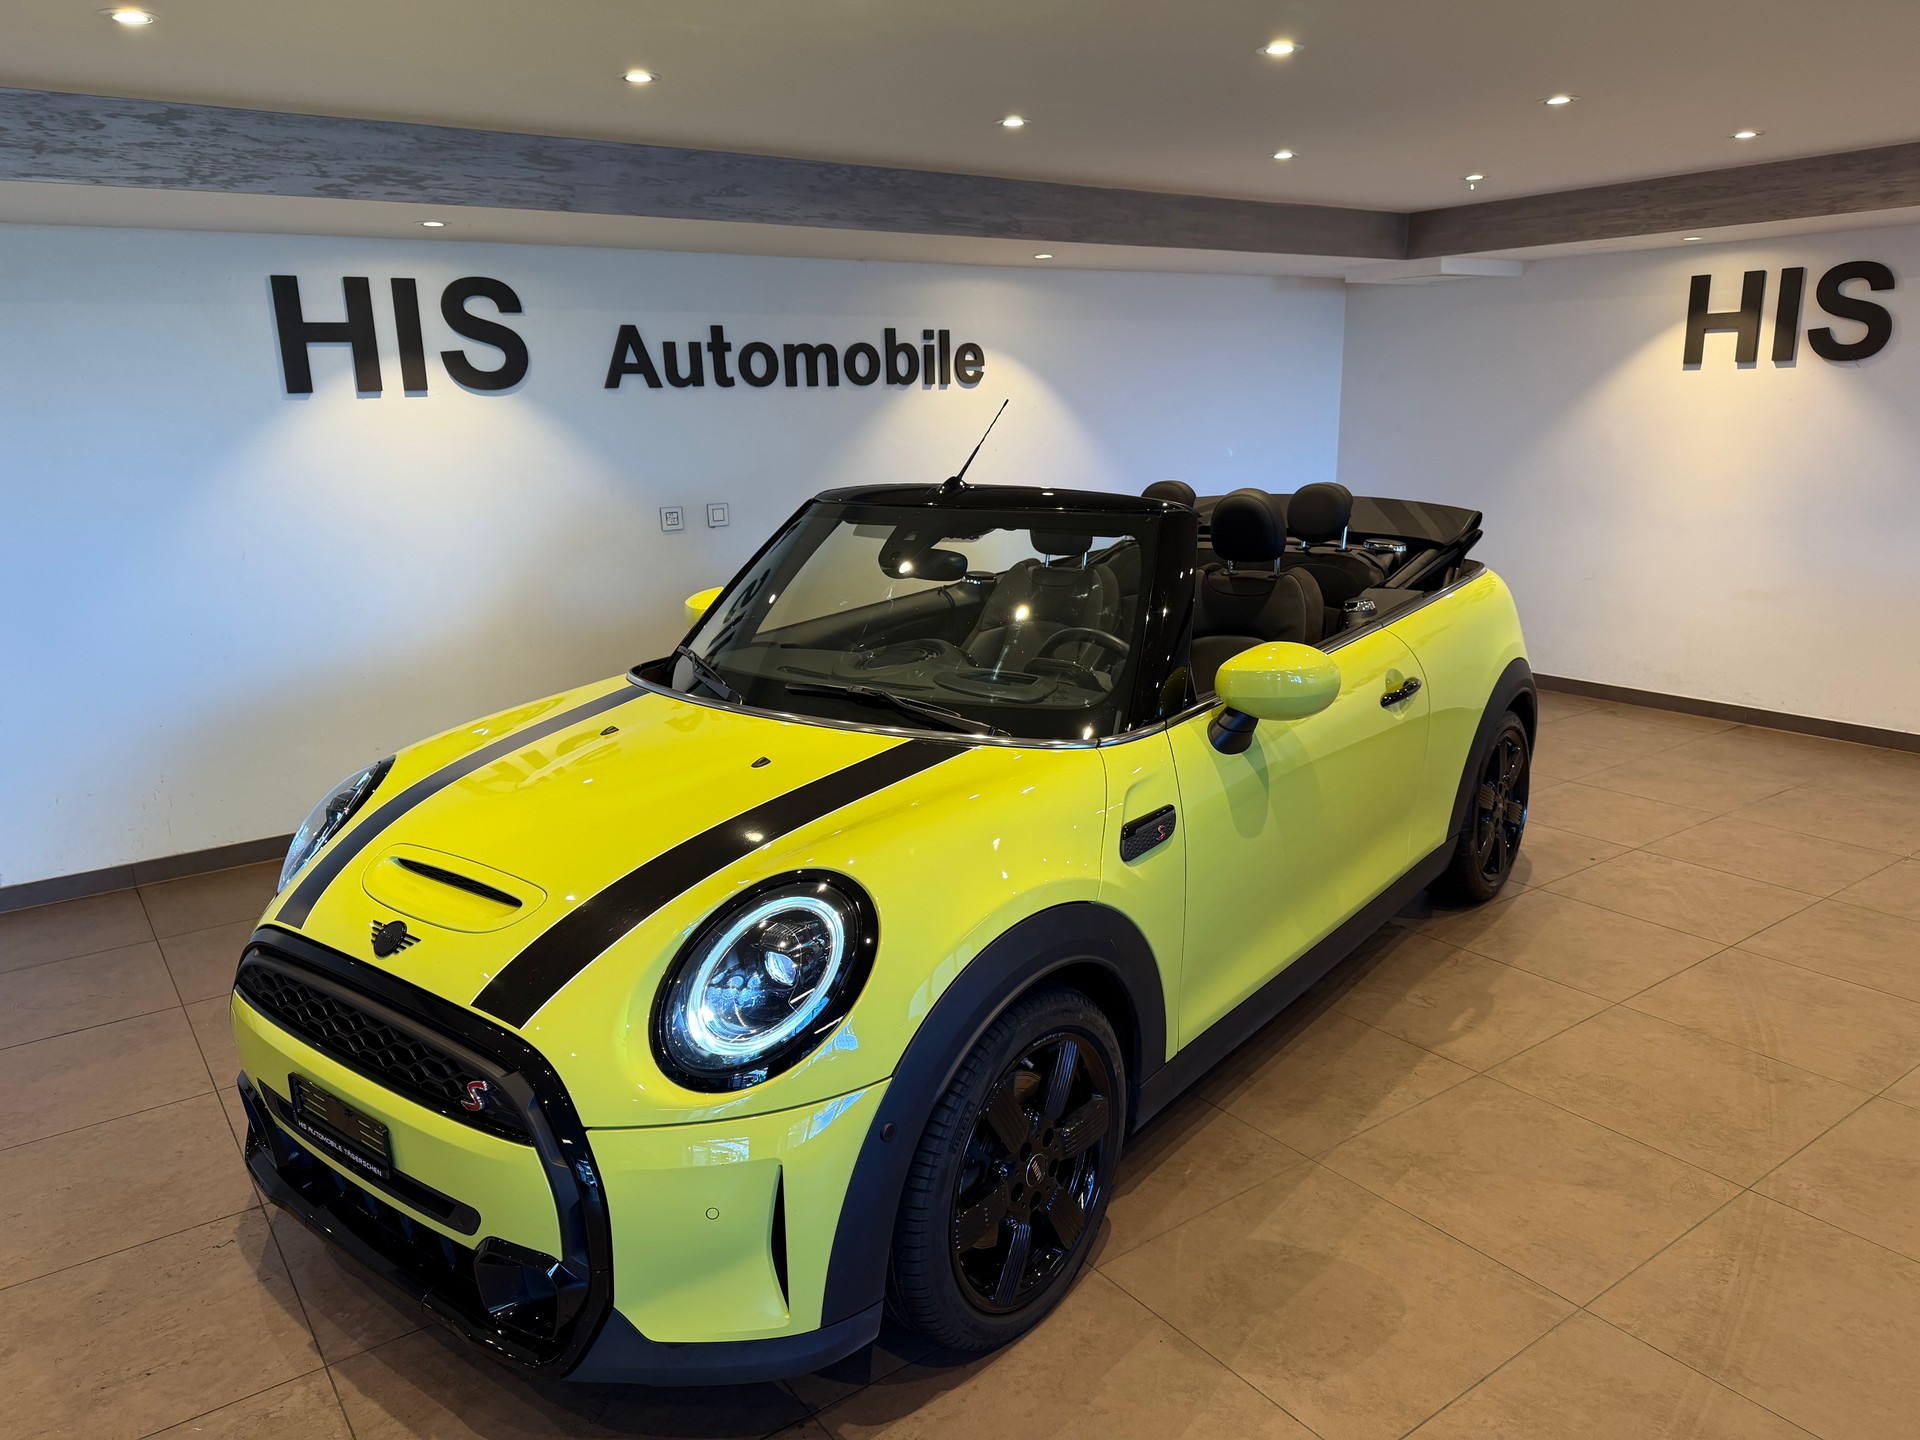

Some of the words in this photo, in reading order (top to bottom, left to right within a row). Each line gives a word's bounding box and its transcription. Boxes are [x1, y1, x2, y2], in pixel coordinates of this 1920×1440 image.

[1683, 261, 1895, 365] HIS
[270, 275, 529, 395] HIS
[604, 324, 985, 390] Automobile
[1156, 825, 1166, 841] S
[460, 1080, 487, 1111] S
[298, 1120, 307, 1130] HIS
